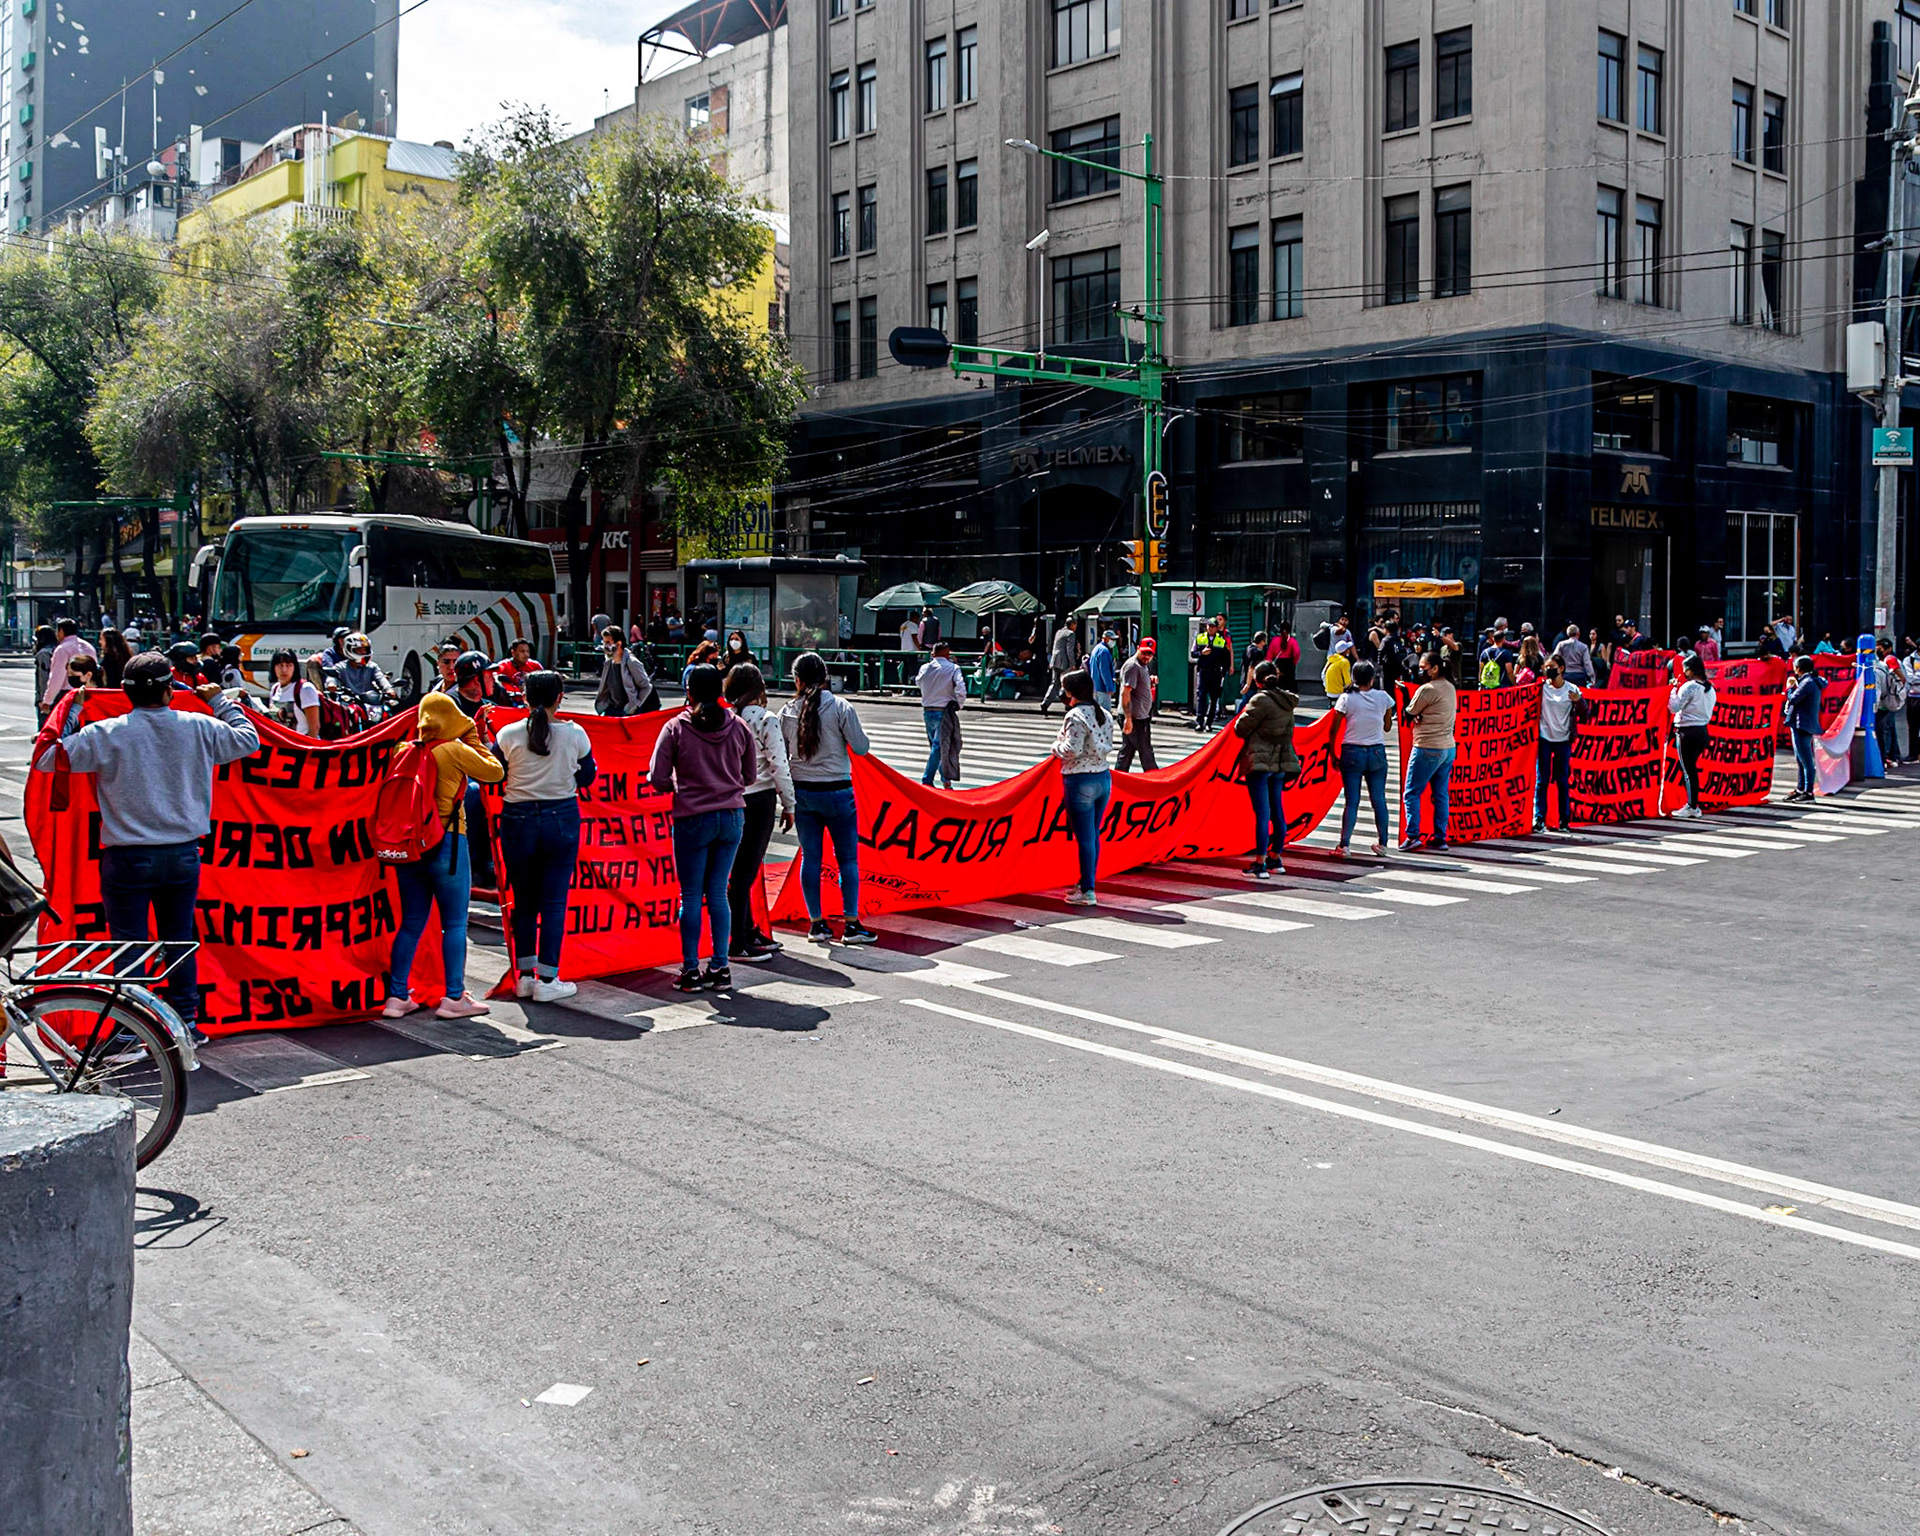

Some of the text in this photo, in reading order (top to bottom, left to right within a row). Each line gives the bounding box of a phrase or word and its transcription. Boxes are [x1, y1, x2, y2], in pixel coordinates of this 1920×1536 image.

[1043, 445, 1125, 466] TELMEX
[1591, 507, 1658, 528] TELMEX
[601, 531, 629, 549] KFC
[376, 849, 408, 860] adidas
